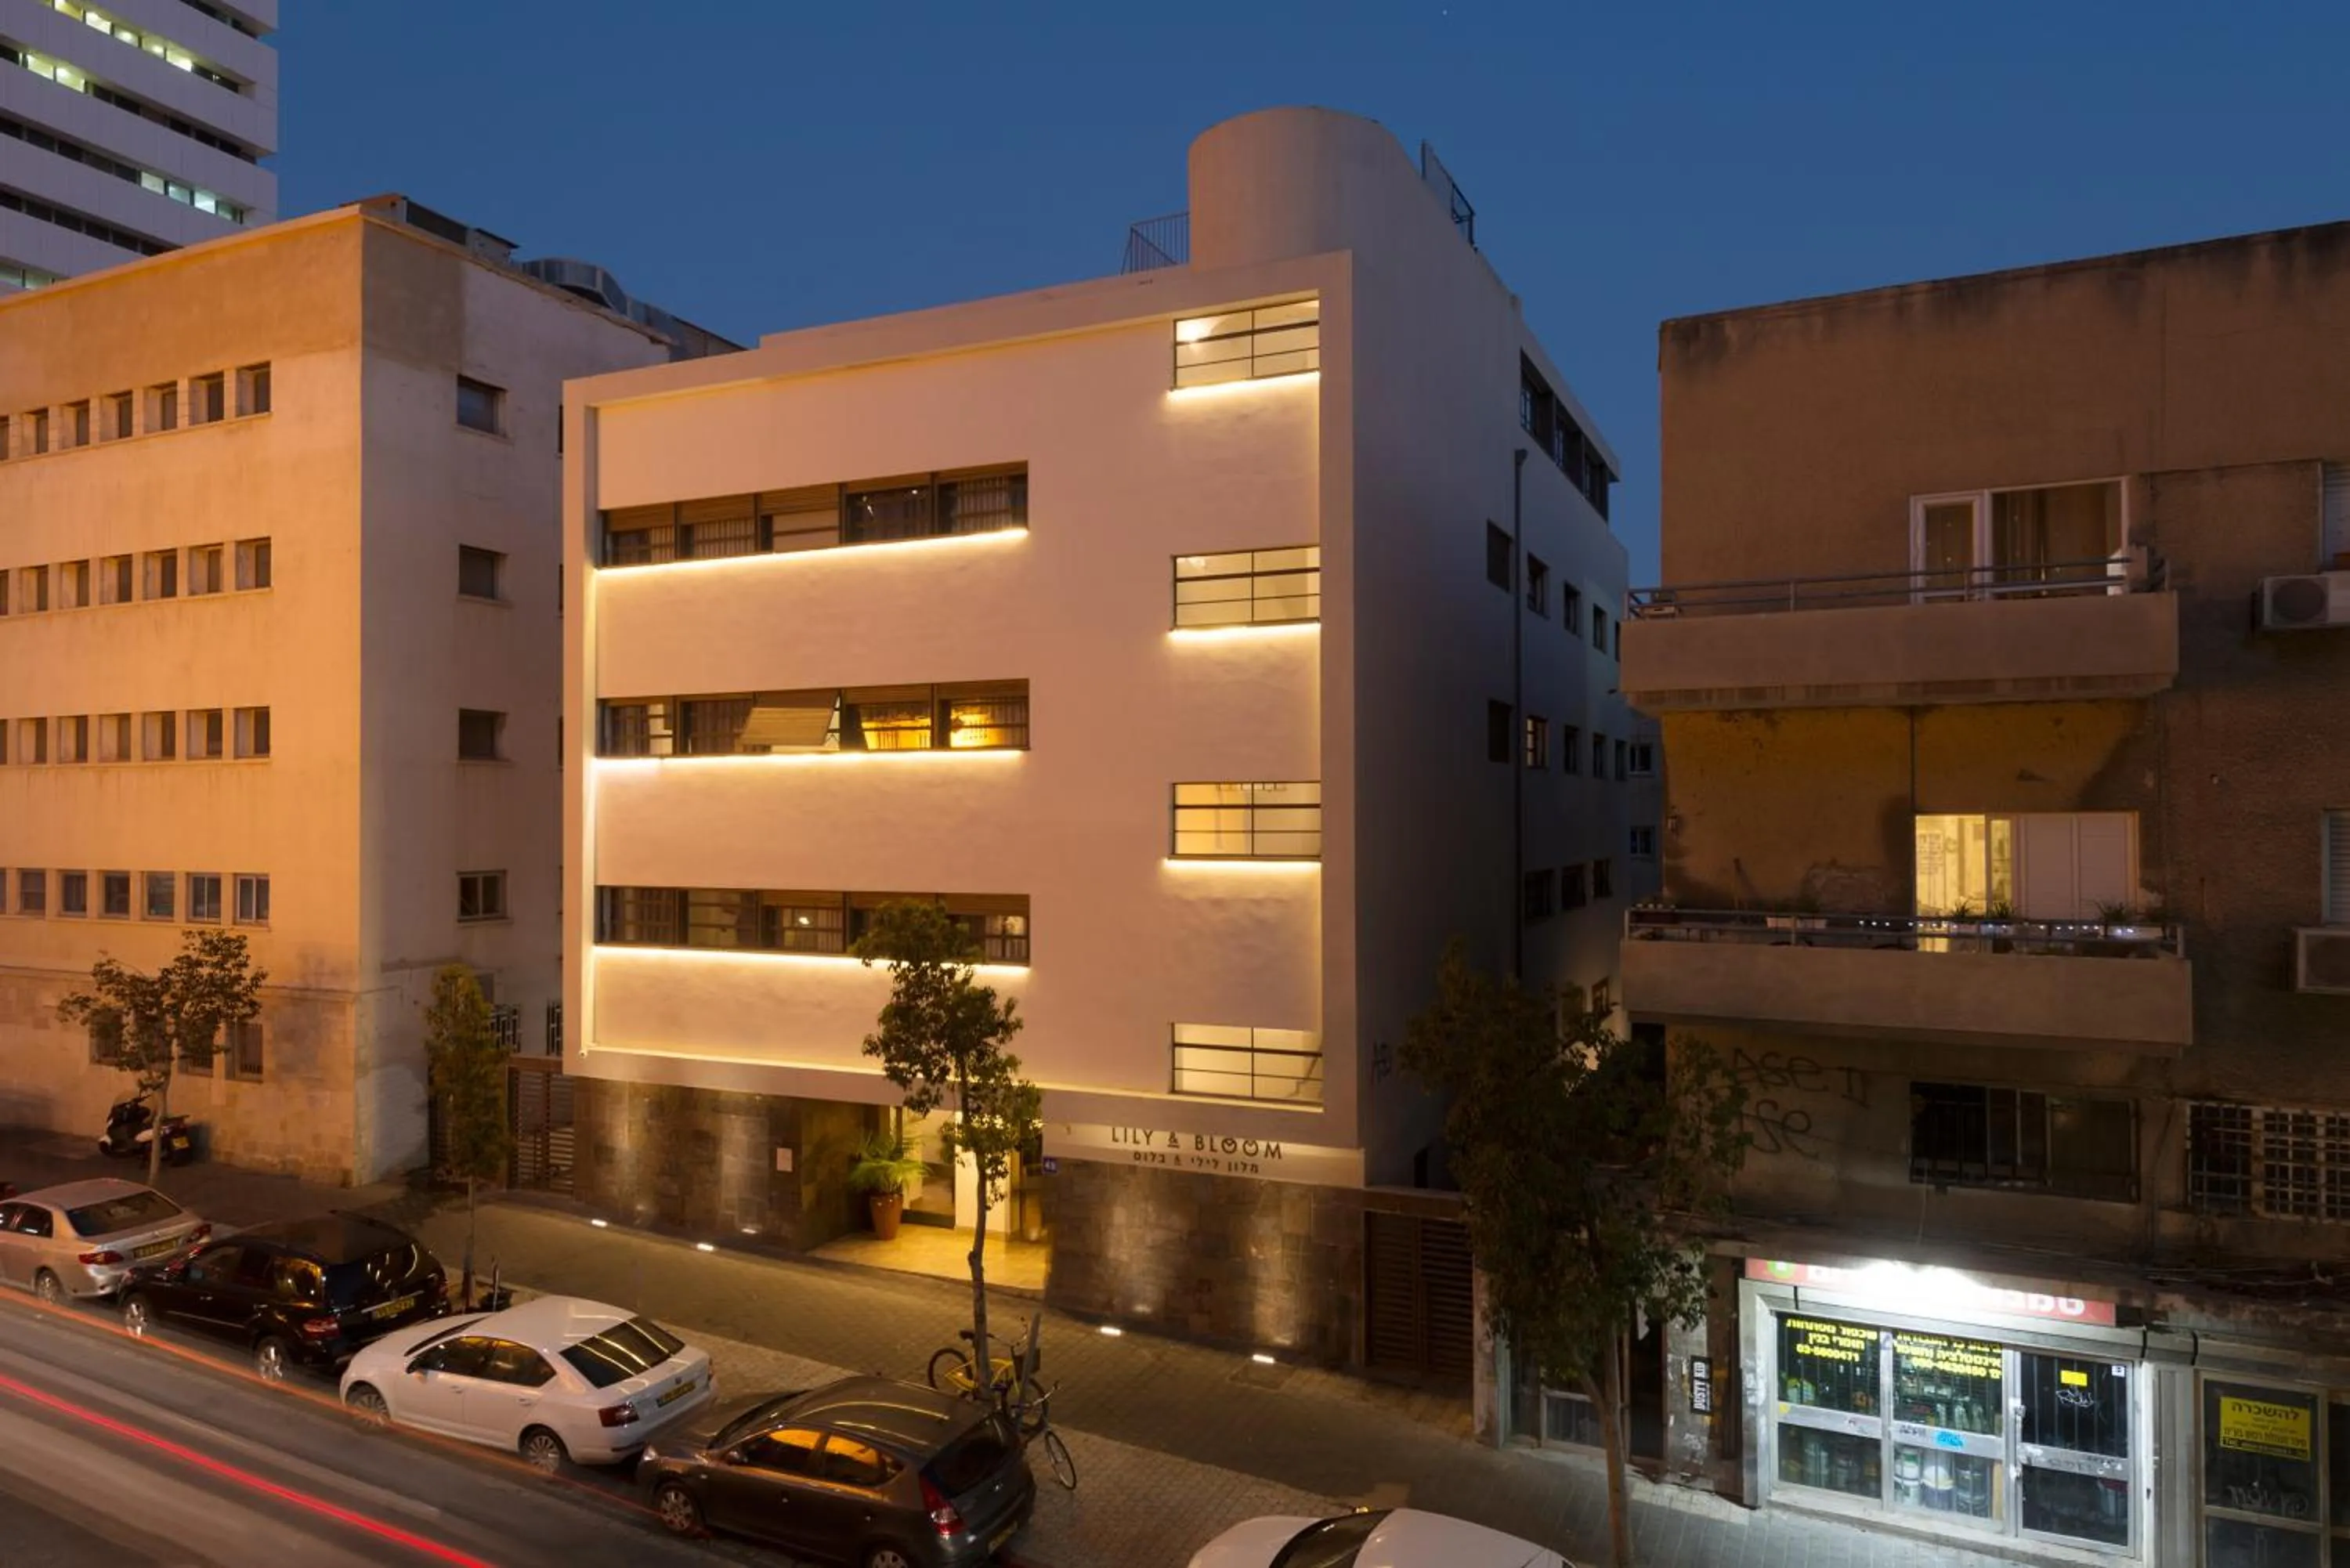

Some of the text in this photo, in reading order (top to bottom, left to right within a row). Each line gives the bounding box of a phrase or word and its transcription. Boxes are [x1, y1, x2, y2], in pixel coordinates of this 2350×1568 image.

[1111, 1127, 1284, 1160] LILY & BLOOM
[1133, 1150, 1166, 1165] בלום
[1227, 1161, 1260, 1174] מלון
[2231, 1400, 2300, 1420] להשכרה
